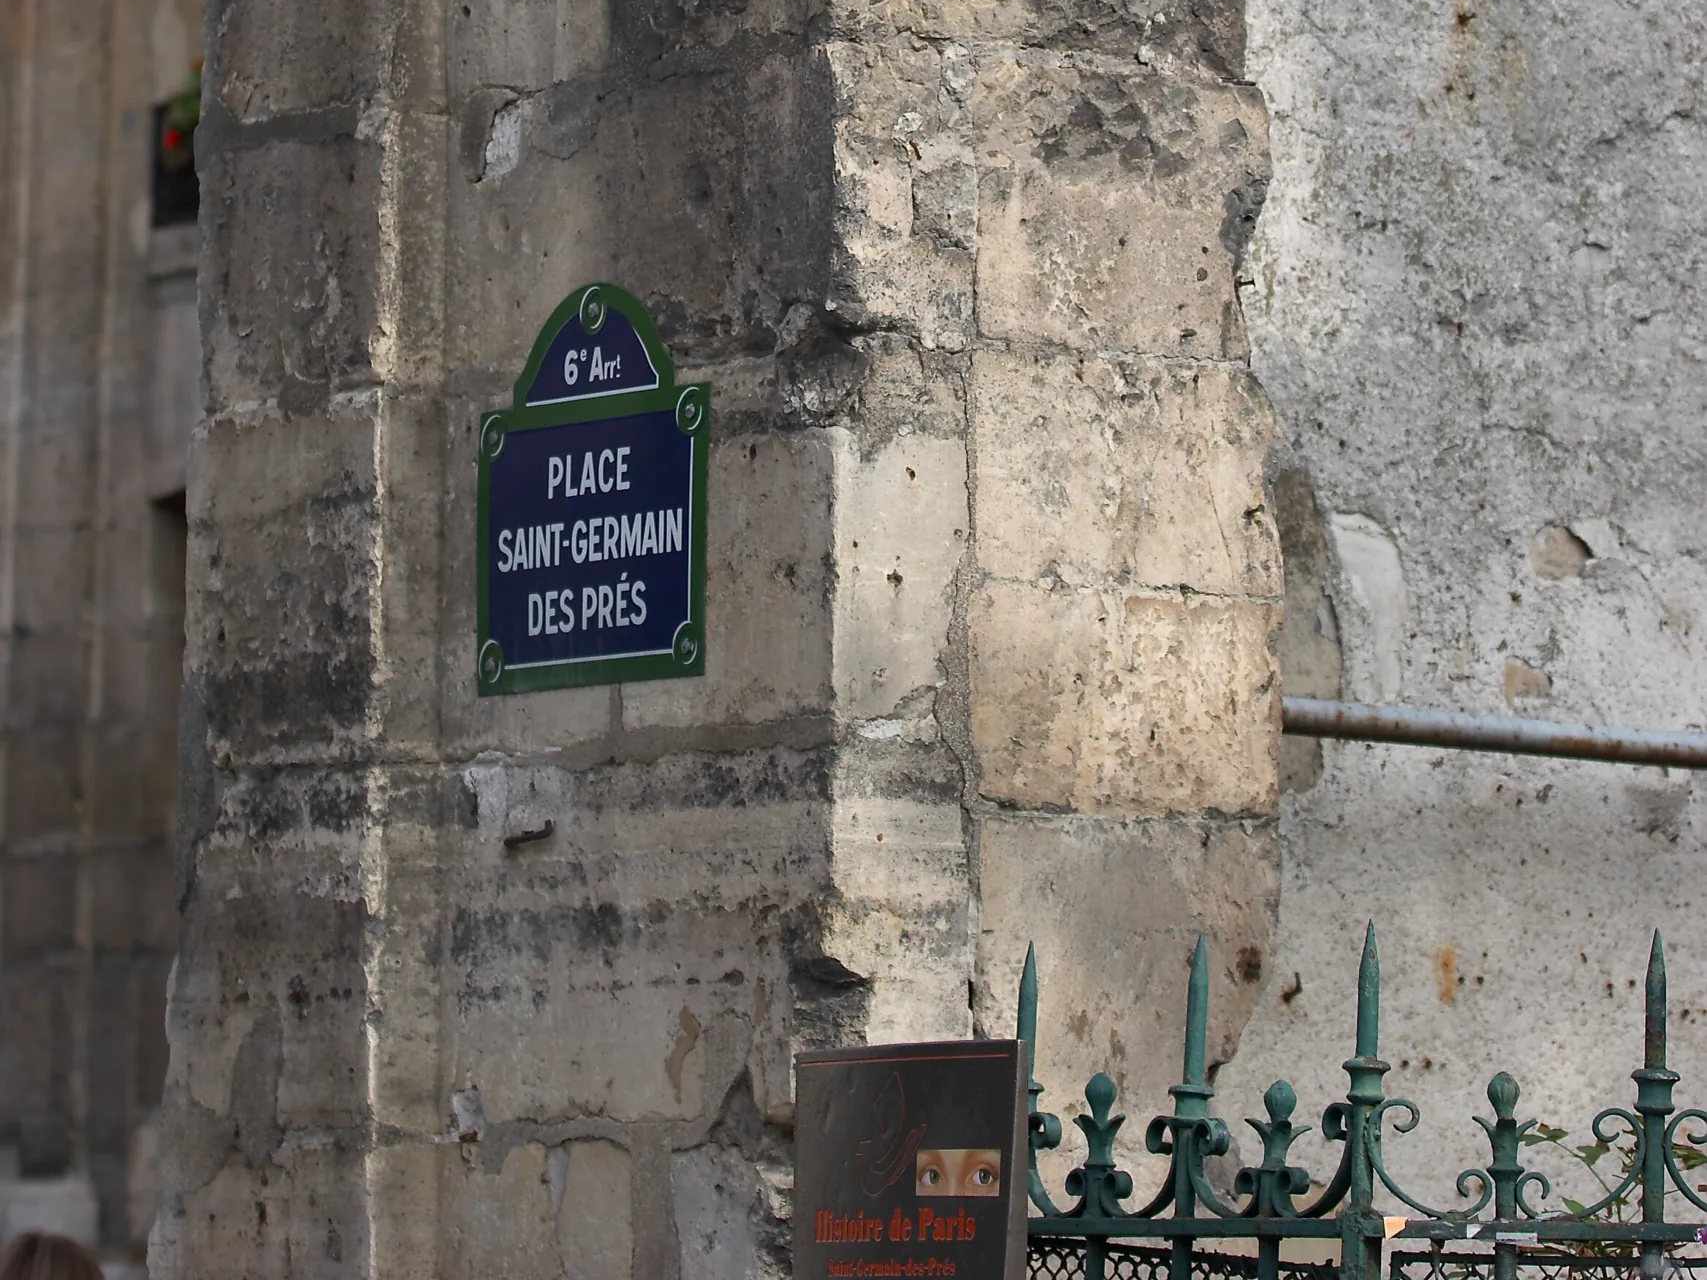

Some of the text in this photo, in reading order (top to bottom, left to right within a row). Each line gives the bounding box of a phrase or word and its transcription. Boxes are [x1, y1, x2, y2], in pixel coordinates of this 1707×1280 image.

[548, 446, 631, 499] PLACE
[497, 508, 683, 573] SAINT-GERMAIN
[528, 572, 648, 637] DES PRÉS
[814, 1206, 976, 1243] Histoire de Paris
